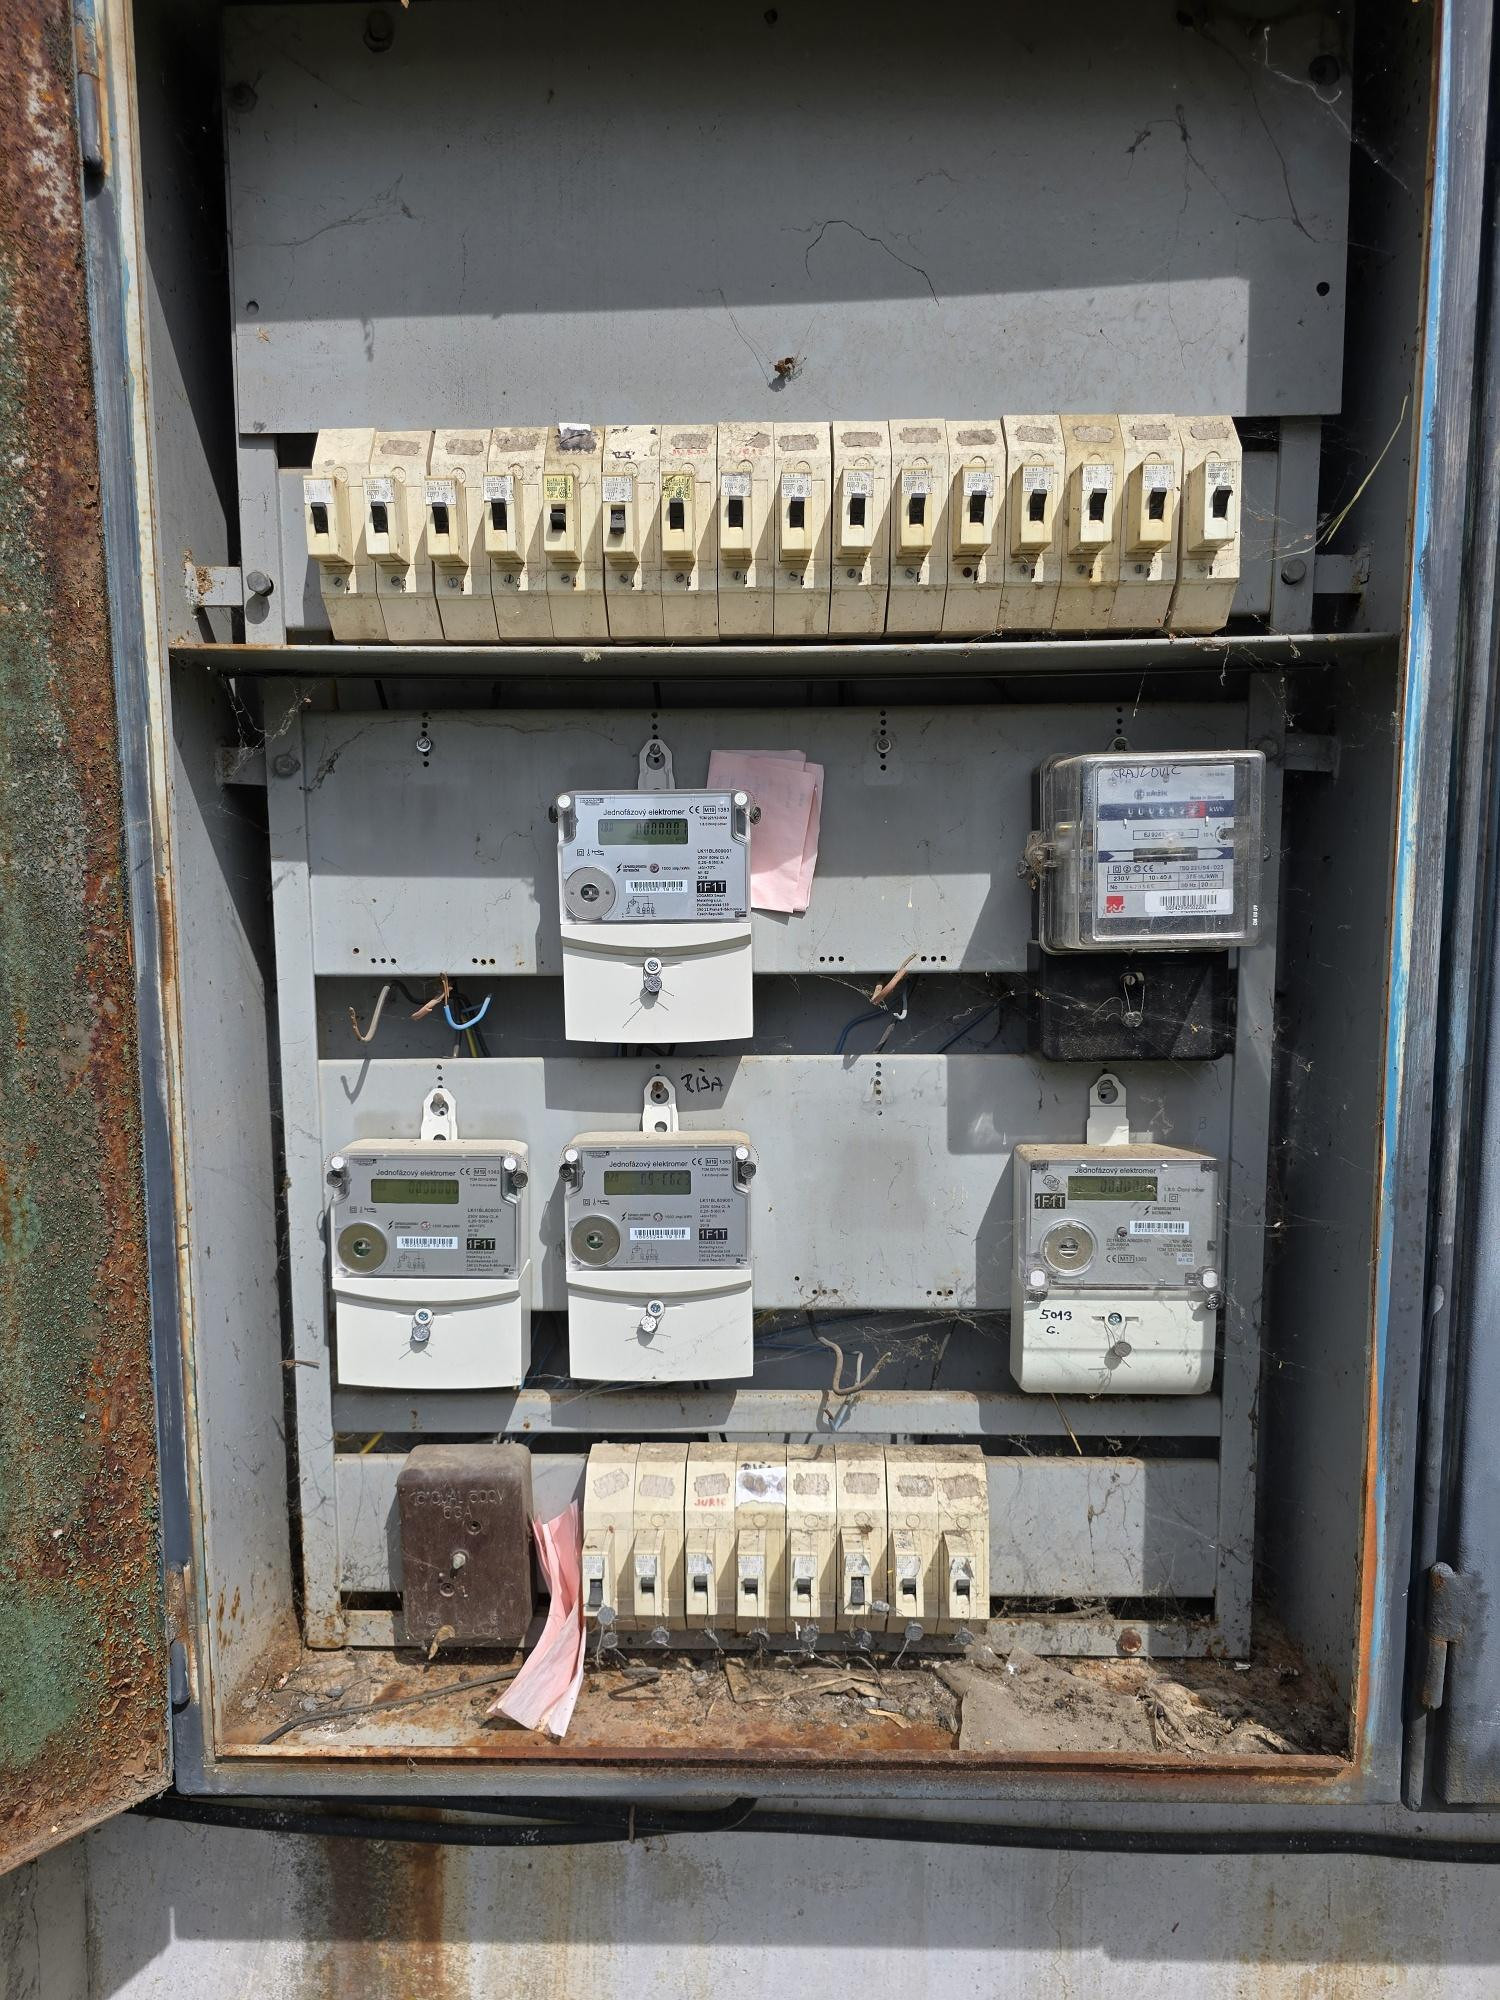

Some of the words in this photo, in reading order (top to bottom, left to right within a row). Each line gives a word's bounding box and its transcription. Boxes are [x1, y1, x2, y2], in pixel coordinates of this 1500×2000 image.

[603, 808, 647, 816] Jednofázový
[648, 808, 686, 816] elektromer
[698, 882, 726, 892] 1F1T
[609, 1160, 651, 1168] Jednofázový
[420, 1169, 456, 1177] elektromer
[1074, 1167, 1119, 1175] Jednofázový
[1119, 1167, 1157, 1175] elektromer
[1035, 1195, 1064, 1208] 1F1T
[699, 1229, 727, 1240] 1F1T
[468, 1239, 495, 1250] 1F1T
[1040, 1309, 1072, 1321] 5013
